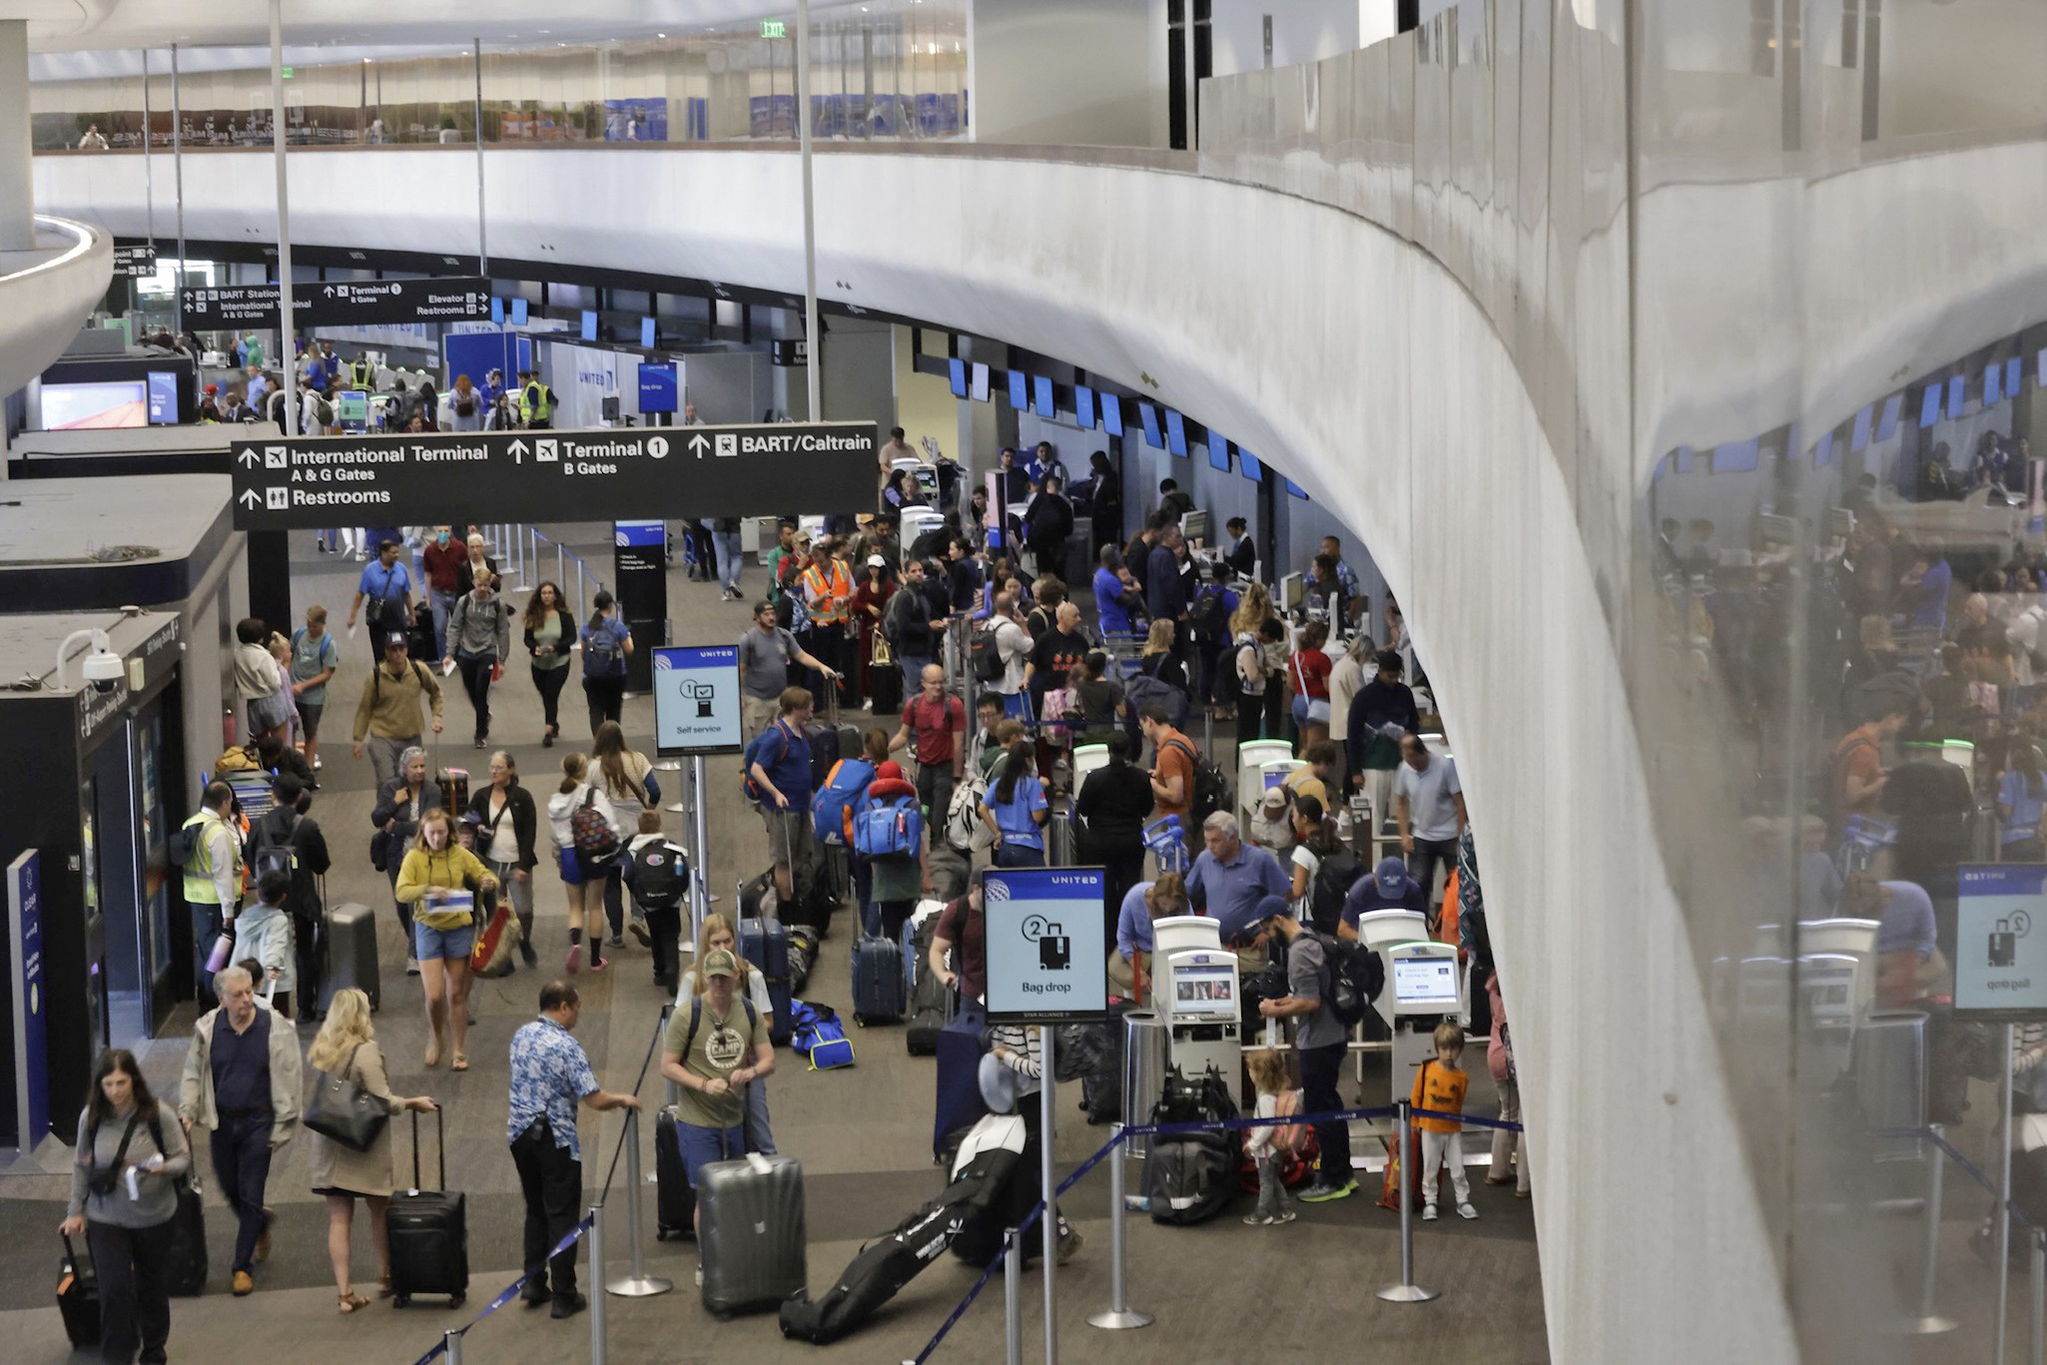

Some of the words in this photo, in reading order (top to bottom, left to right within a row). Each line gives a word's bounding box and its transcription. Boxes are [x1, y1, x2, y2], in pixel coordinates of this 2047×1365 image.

[220, 290, 245, 299] BART
[247, 289, 280, 298] Station
[351, 285, 389, 295] Terminal
[428, 295, 464, 303] Elevator
[220, 301, 274, 311] International
[416, 304, 465, 316] Restrooms
[580, 371, 605, 386] UNITED
[563, 440, 642, 459] Terminal
[742, 434, 872, 453] BART/Caltrain
[291, 447, 405, 465] International
[411, 444, 488, 462] Terminal
[291, 469, 302, 482] A
[305, 469, 317, 482] &
[320, 468, 332, 482] G
[335, 467, 376, 481] Gates
[564, 463, 574, 475] B
[577, 462, 617, 475] Gates
[292, 489, 391, 506] Restrooms
[677, 726, 692, 734] Self
[693, 725, 721, 733] service
[1051, 876, 1098, 884] UNITED
[1030, 921, 1041, 935] 2
[1022, 982, 1043, 994] Bag
[1045, 982, 1071, 994] drop
[711, 1043, 740, 1054] CAMP
